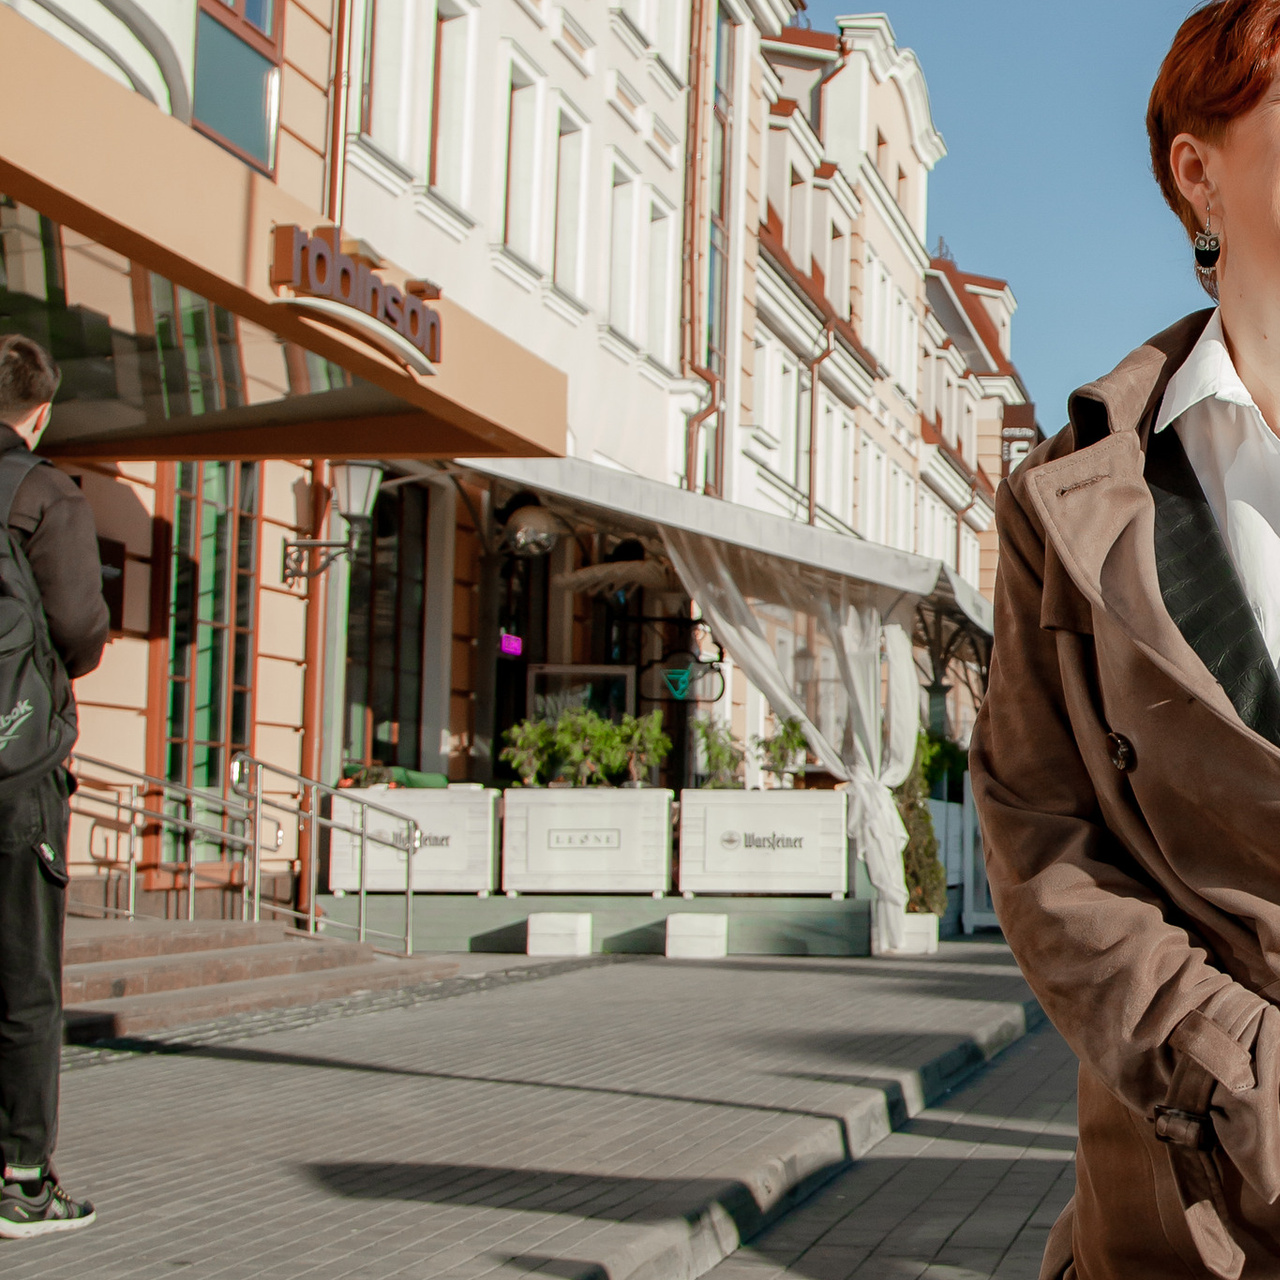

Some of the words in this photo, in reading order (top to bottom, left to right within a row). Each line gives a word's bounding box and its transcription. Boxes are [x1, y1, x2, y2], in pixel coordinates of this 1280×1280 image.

[292, 225, 441, 363] robinson
[0, 699, 34, 729] bok
[744, 831, 804, 850] Warsteiner
